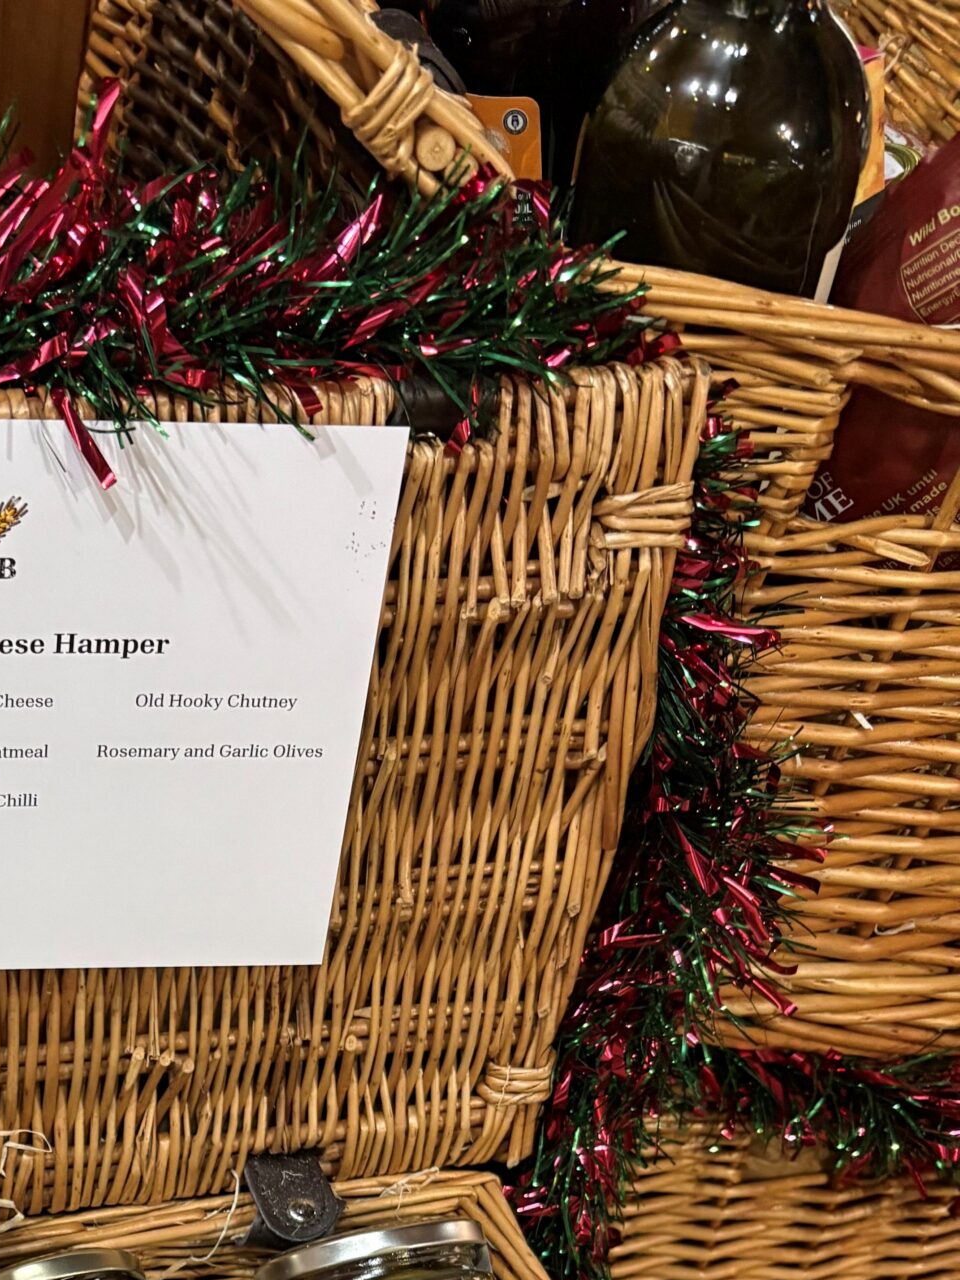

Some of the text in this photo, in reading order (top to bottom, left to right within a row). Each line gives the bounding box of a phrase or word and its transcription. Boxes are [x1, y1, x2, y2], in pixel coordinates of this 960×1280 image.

[909, 217, 937, 247] Wild
[903, 250, 940, 276] Nutrition
[806, 472, 834, 499] OF
[882, 493, 906, 512] UK
[907, 469, 938, 496] until
[909, 481, 948, 513] made
[52, 632, 171, 660] Hamper
[135, 692, 298, 712] Old Hooky Chutney
[96, 743, 324, 762] Rosemary and Garlic Olives
